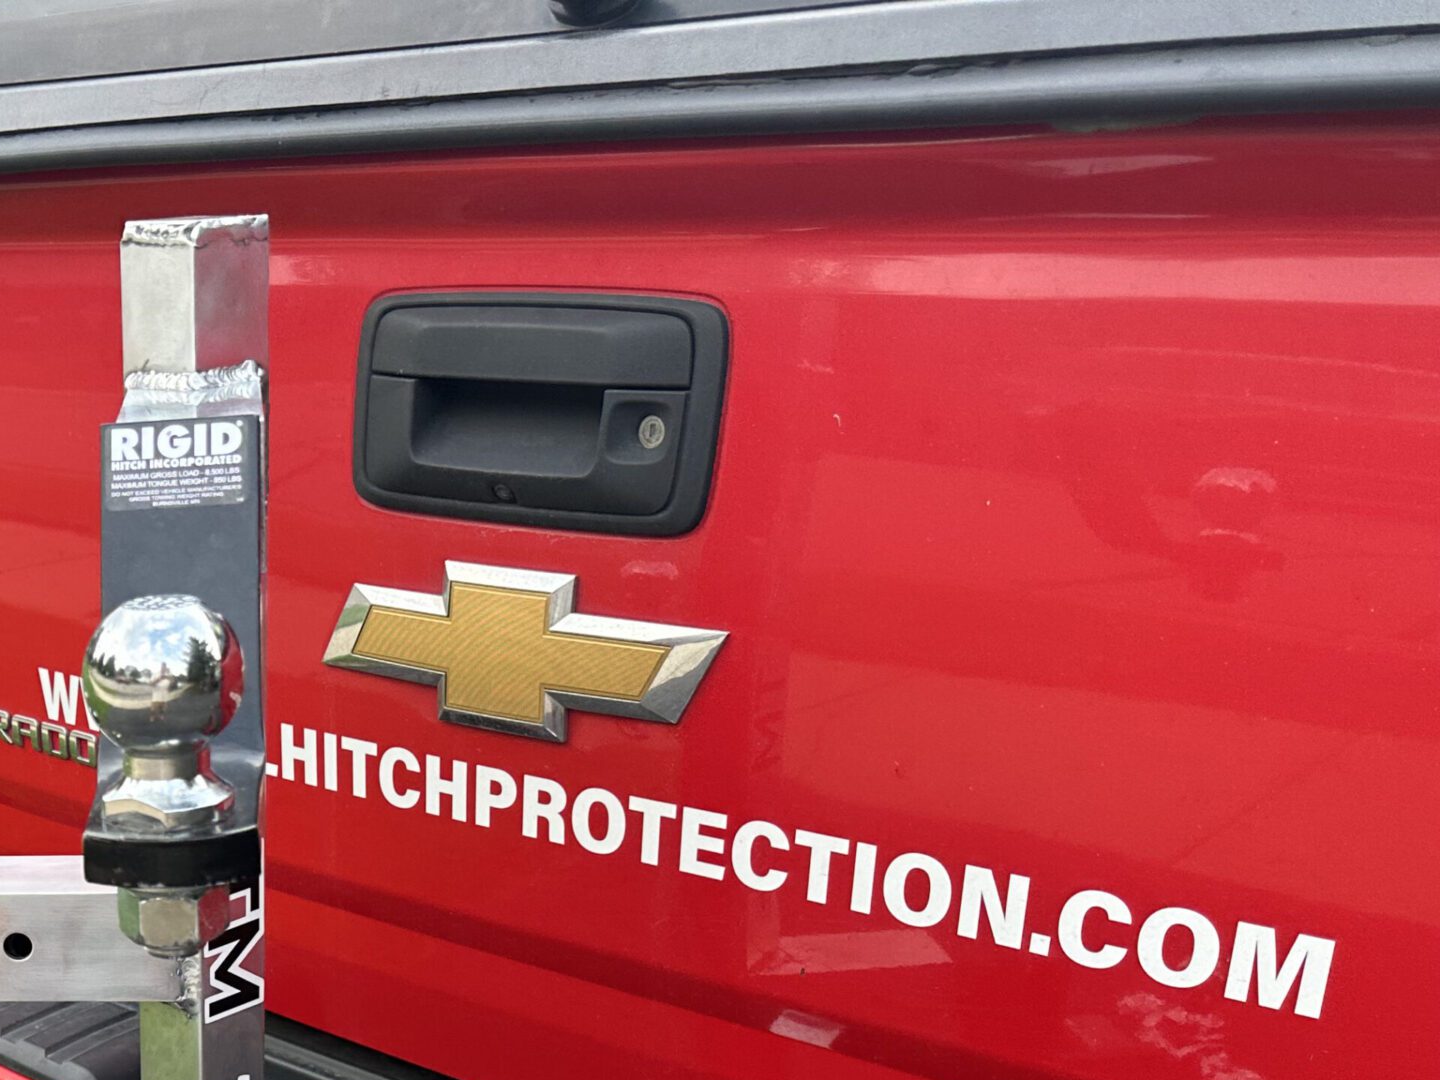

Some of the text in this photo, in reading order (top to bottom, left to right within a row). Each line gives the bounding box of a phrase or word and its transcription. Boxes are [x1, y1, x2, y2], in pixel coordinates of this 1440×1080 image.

[111, 421, 243, 461] RIGID
[111, 453, 242, 471] HITCH INCORPORATED
[111, 481, 146, 490] MAXIMUM
[148, 479, 178, 488] TONGUE
[179, 477, 208, 486] WEIGHT
[227, 474, 242, 483] LBS
[113, 472, 149, 481] MAXIMUM
[150, 470, 177, 479] GROSS
[179, 469, 200, 478] LOAD
[225, 466, 240, 475] LBS
